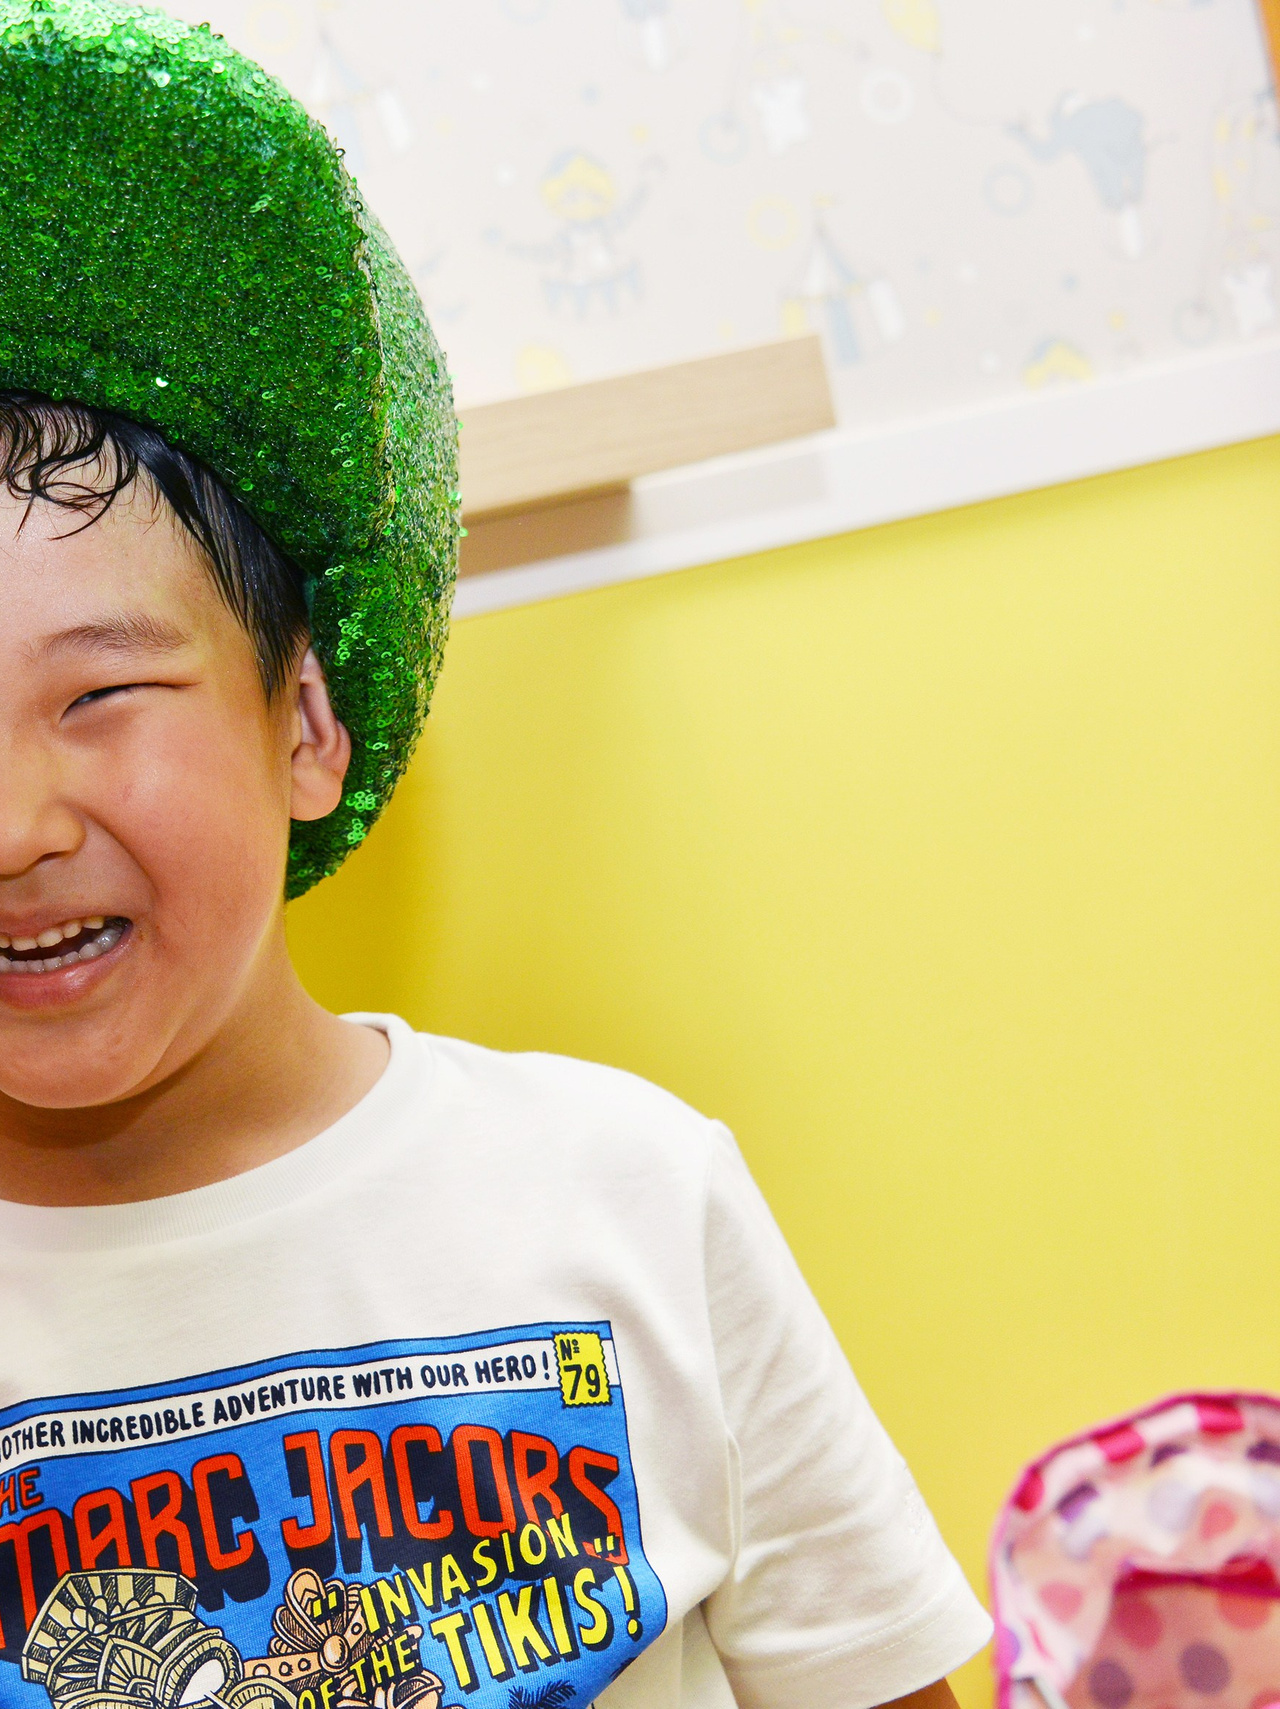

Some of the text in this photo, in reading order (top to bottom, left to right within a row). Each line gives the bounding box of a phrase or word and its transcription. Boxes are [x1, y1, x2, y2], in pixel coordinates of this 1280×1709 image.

[72, 1401, 207, 1445] INCREDIBLE
[213, 1374, 346, 1425] ADVENTURE
[352, 1365, 414, 1398] WITH
[420, 1363, 470, 1389] OUR
[563, 1363, 602, 1401] 79
[297, 1564, 640, 1709] OF THE TIKIS!
